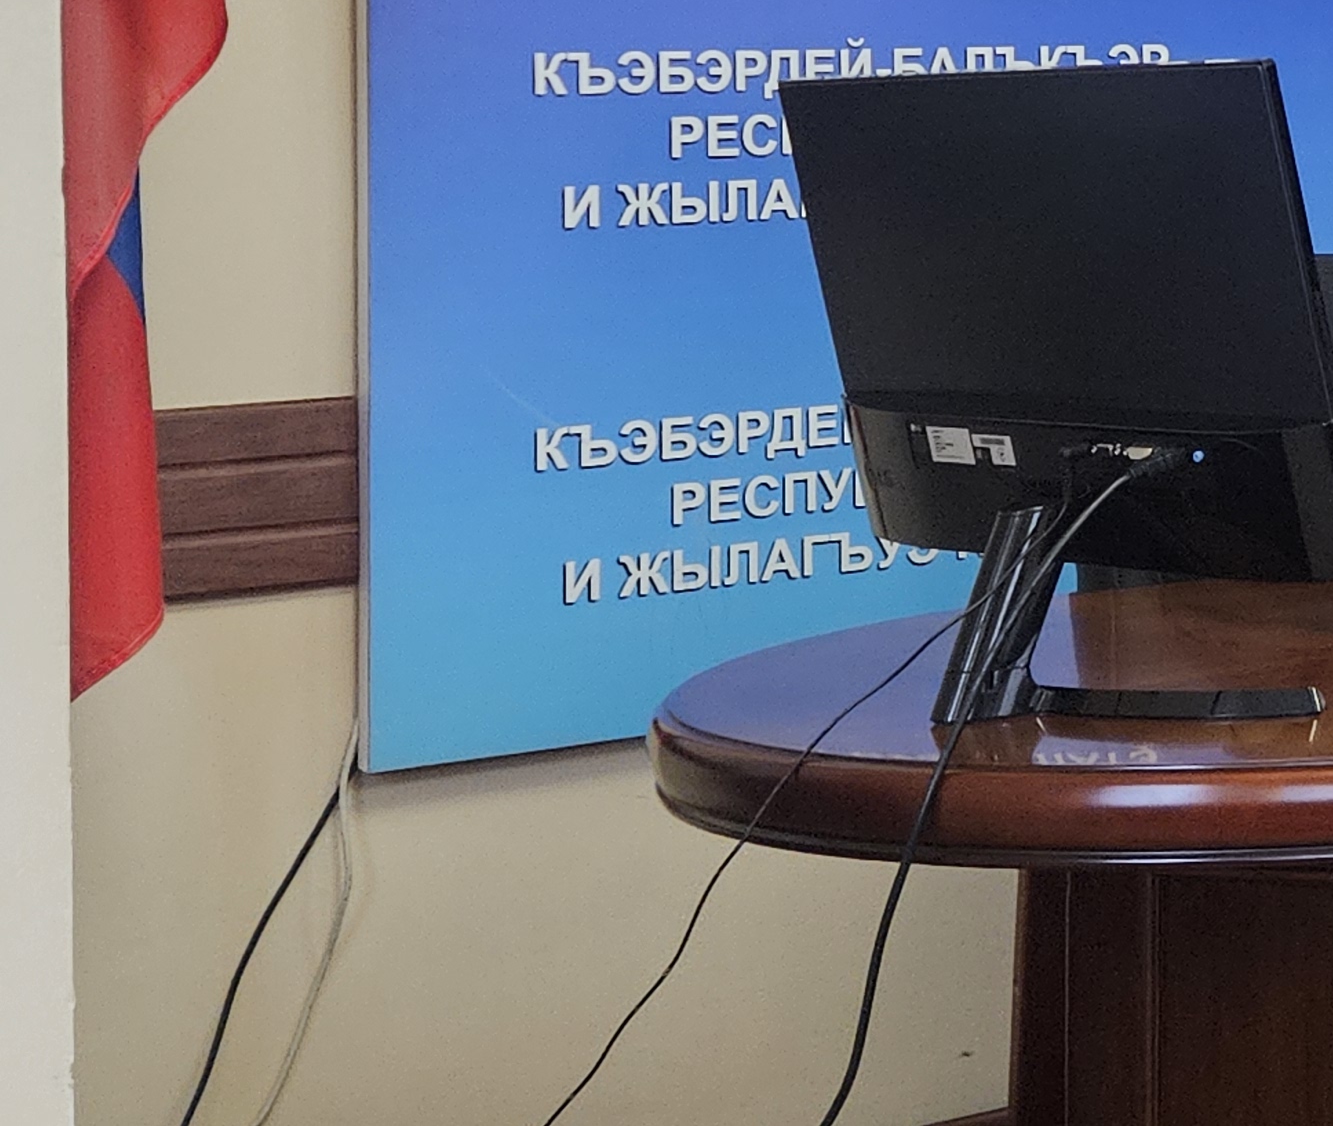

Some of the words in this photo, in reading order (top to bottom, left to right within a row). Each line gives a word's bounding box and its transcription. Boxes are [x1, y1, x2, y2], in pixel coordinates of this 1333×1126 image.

[669, 114, 792, 159] РЕС
[563, 184, 602, 230] И
[616, 178, 807, 228] ЖЫЛА
[563, 558, 602, 604] И
